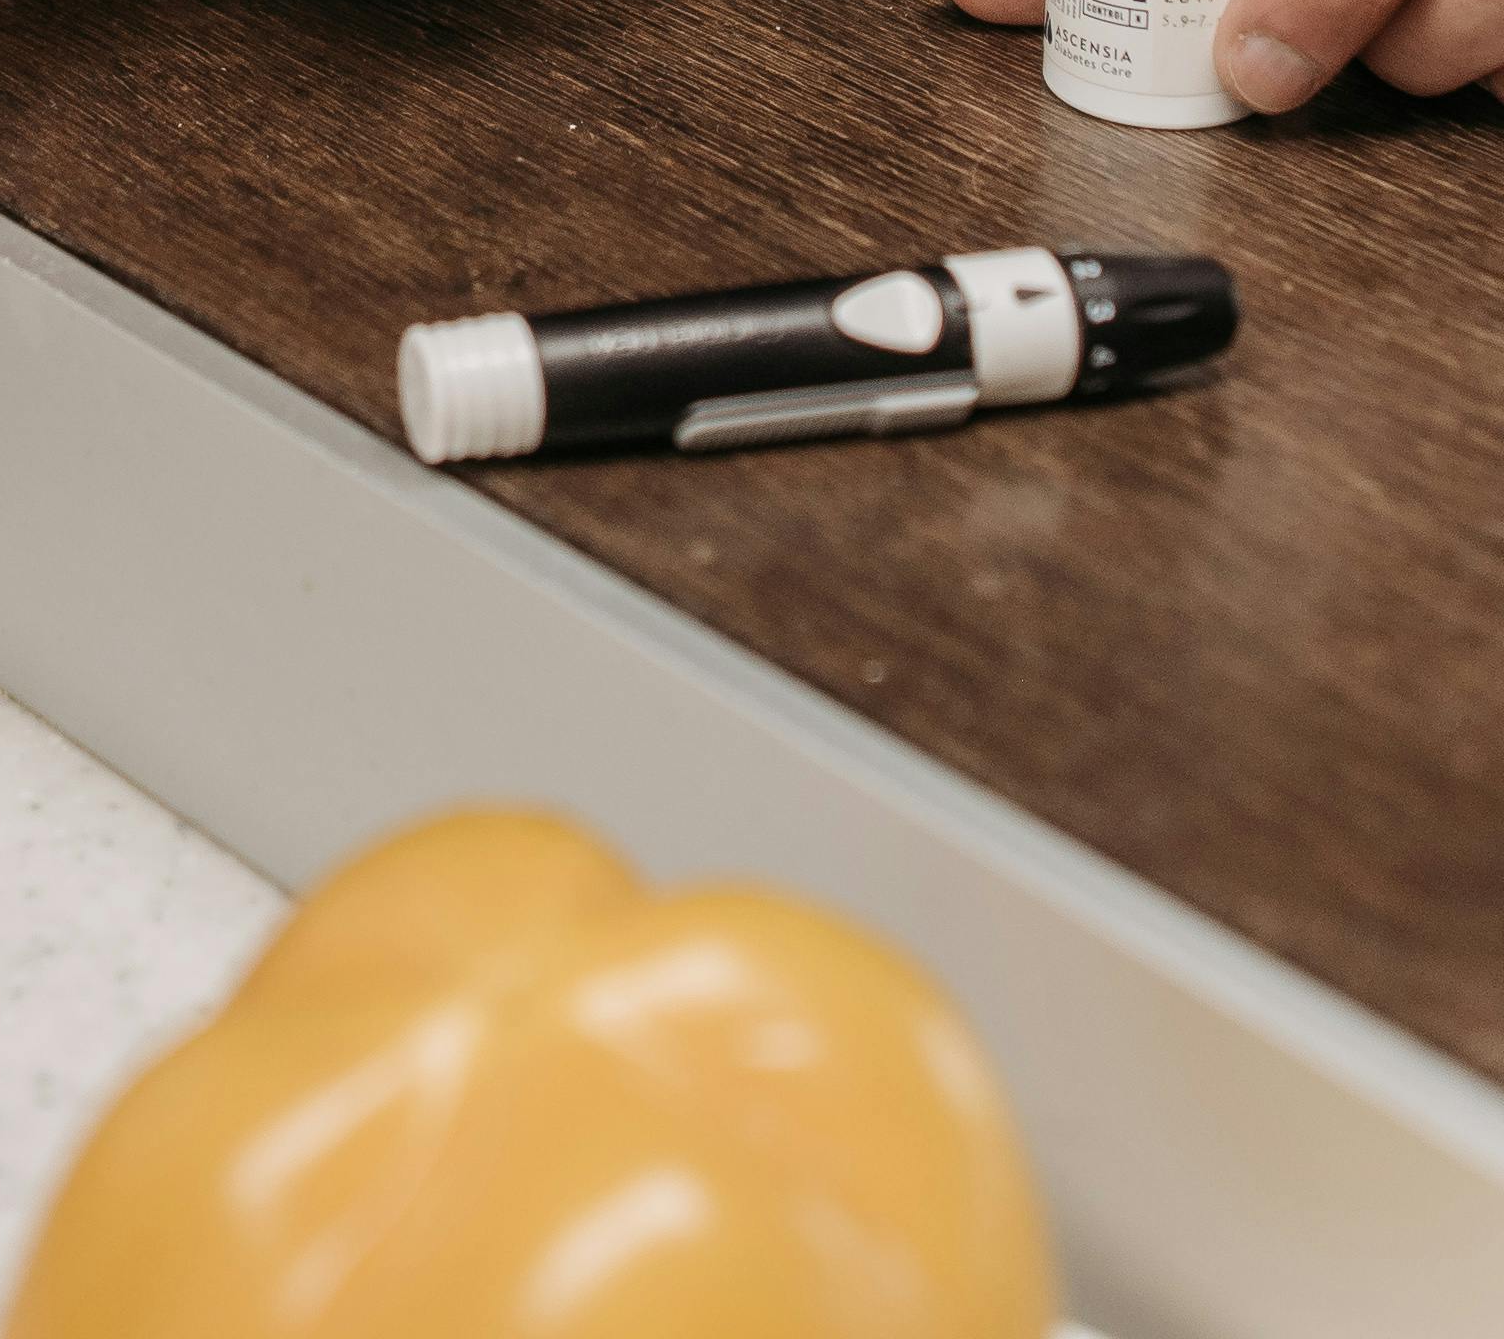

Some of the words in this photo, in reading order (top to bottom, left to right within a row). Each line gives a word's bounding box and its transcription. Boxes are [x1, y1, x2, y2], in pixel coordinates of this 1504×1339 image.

[1086, 2, 1125, 21] CONTROL
[1054, 41, 1097, 71] Diabetes
[1101, 62, 1133, 79] Care
[1055, 25, 1133, 64] ASCENSIA
